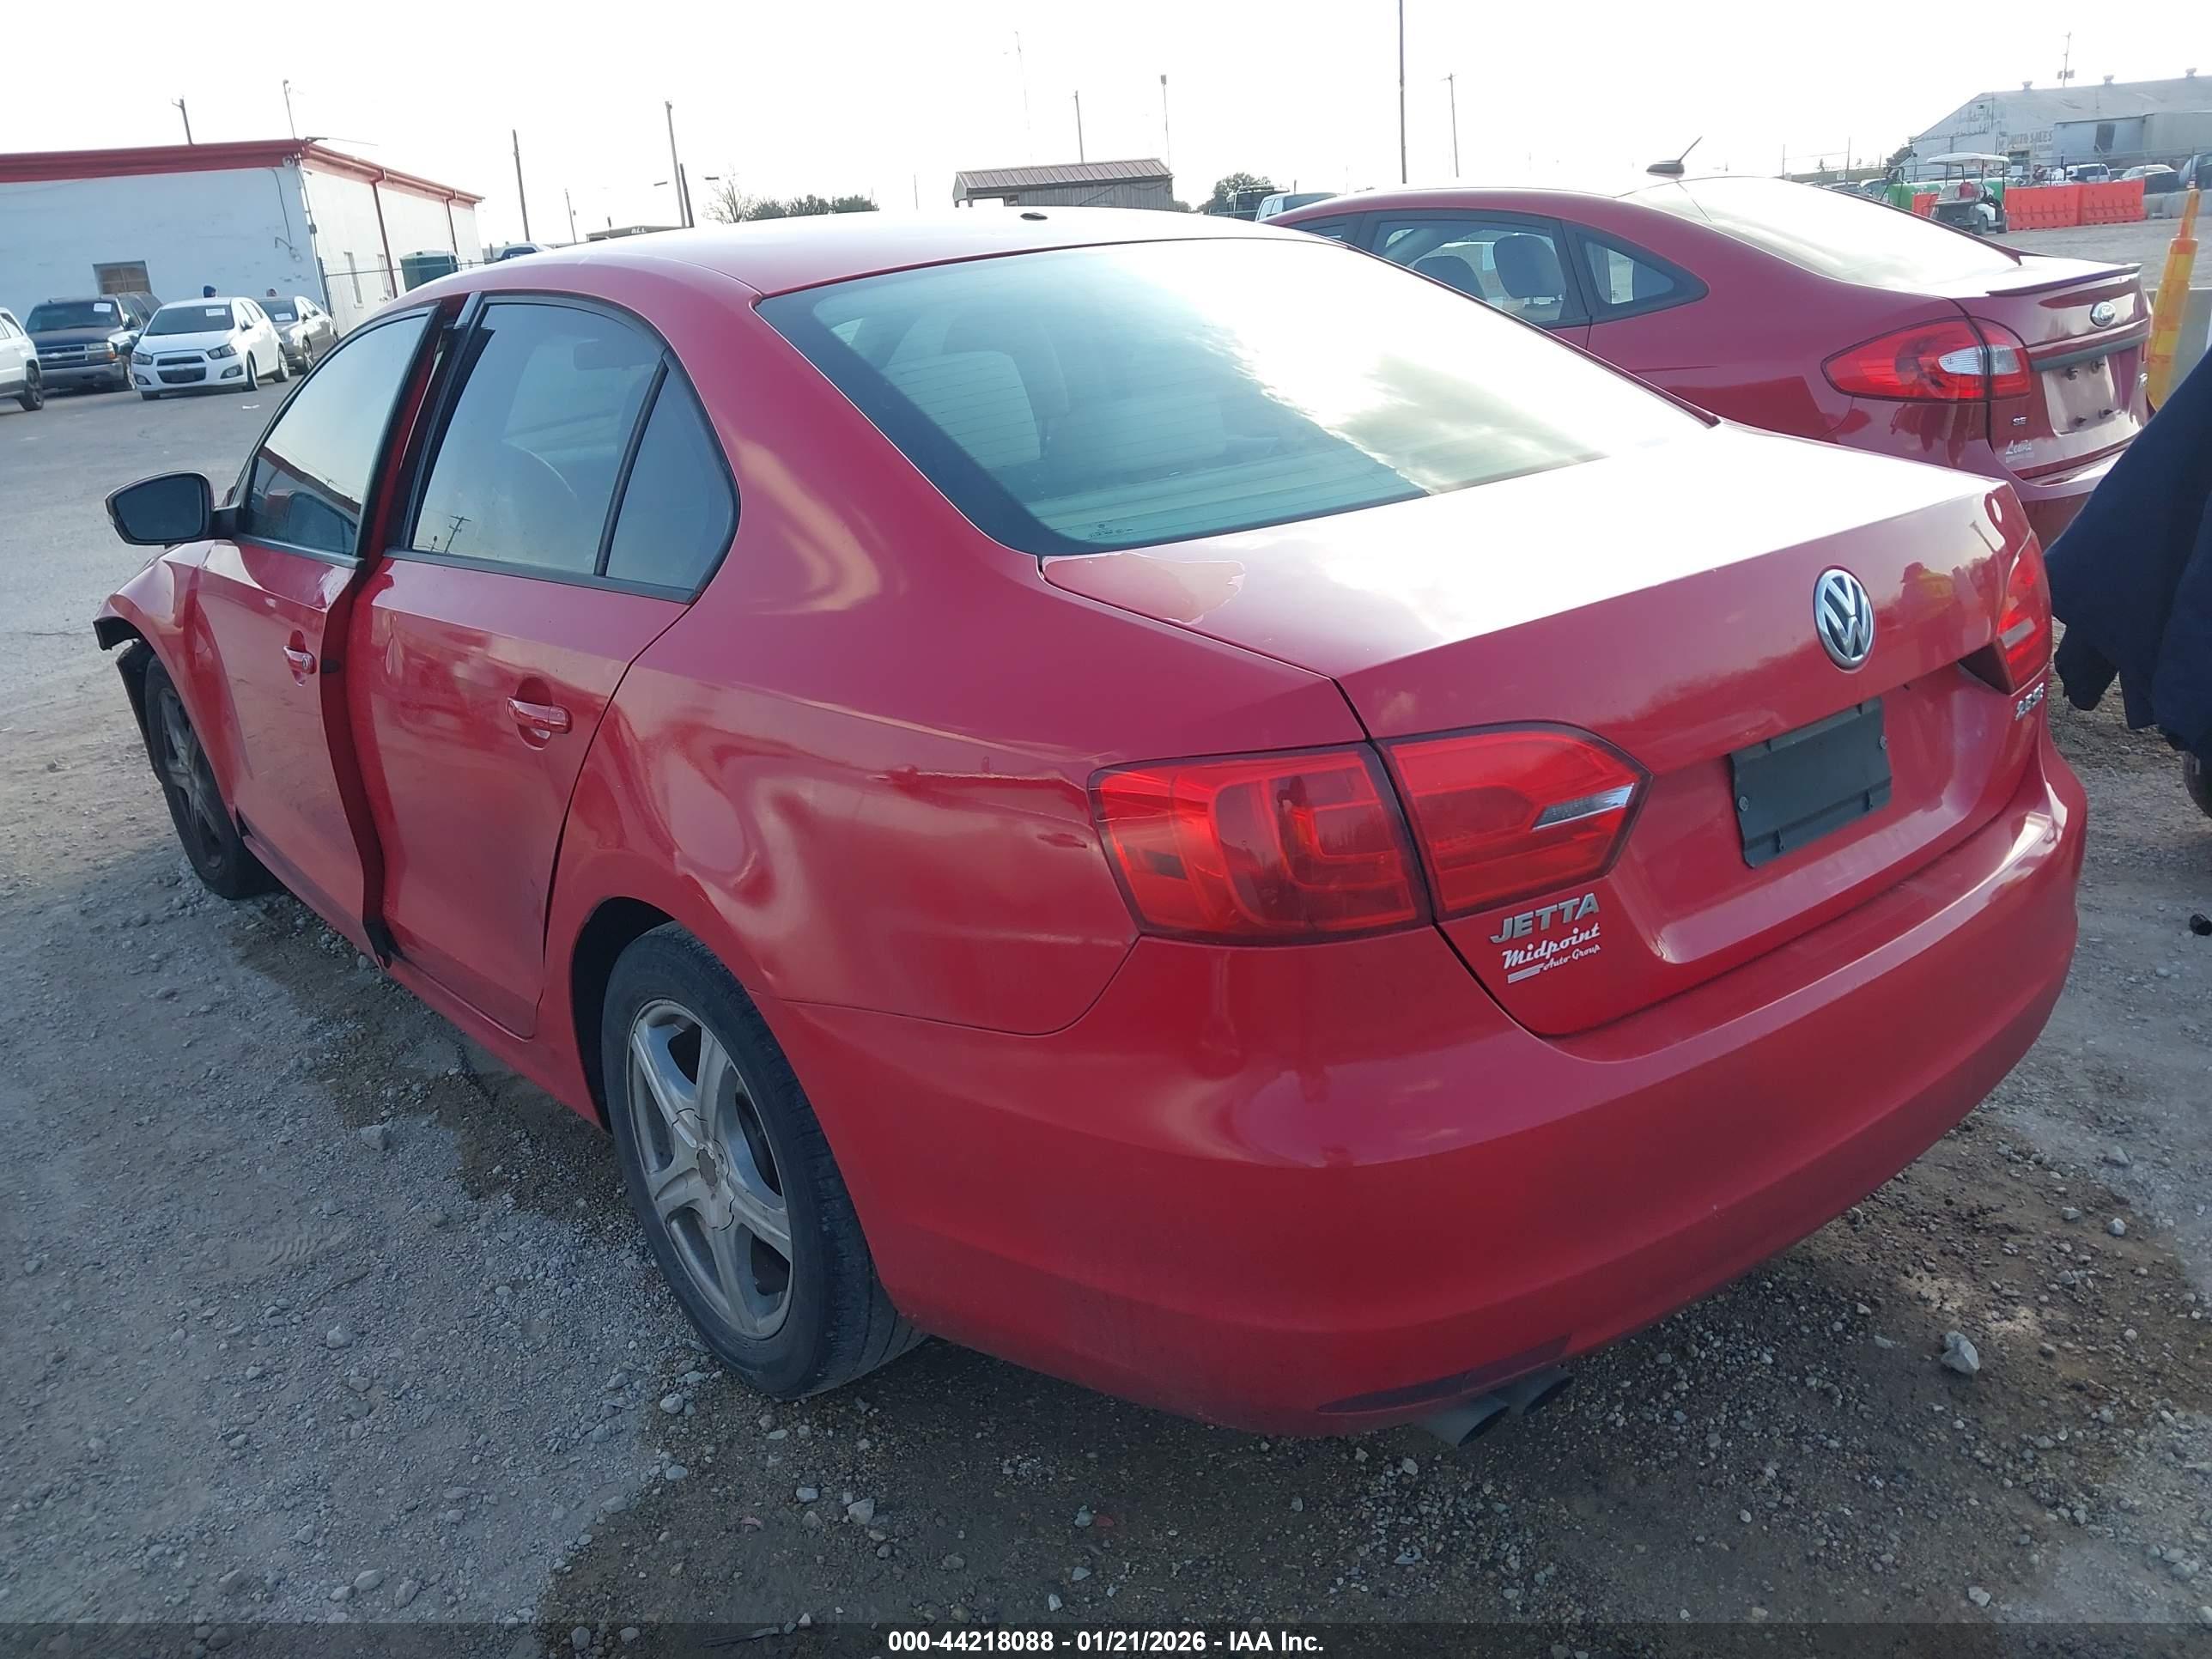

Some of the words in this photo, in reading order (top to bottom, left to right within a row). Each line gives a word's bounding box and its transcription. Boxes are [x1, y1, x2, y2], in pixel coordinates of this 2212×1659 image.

[2012, 416, 2027, 426] SE
[1490, 892, 1600, 944] JETTA
[1502, 922, 1601, 969] Midpoint
[1543, 954, 1571, 971] Auto
[1571, 944, 1601, 960] Group
